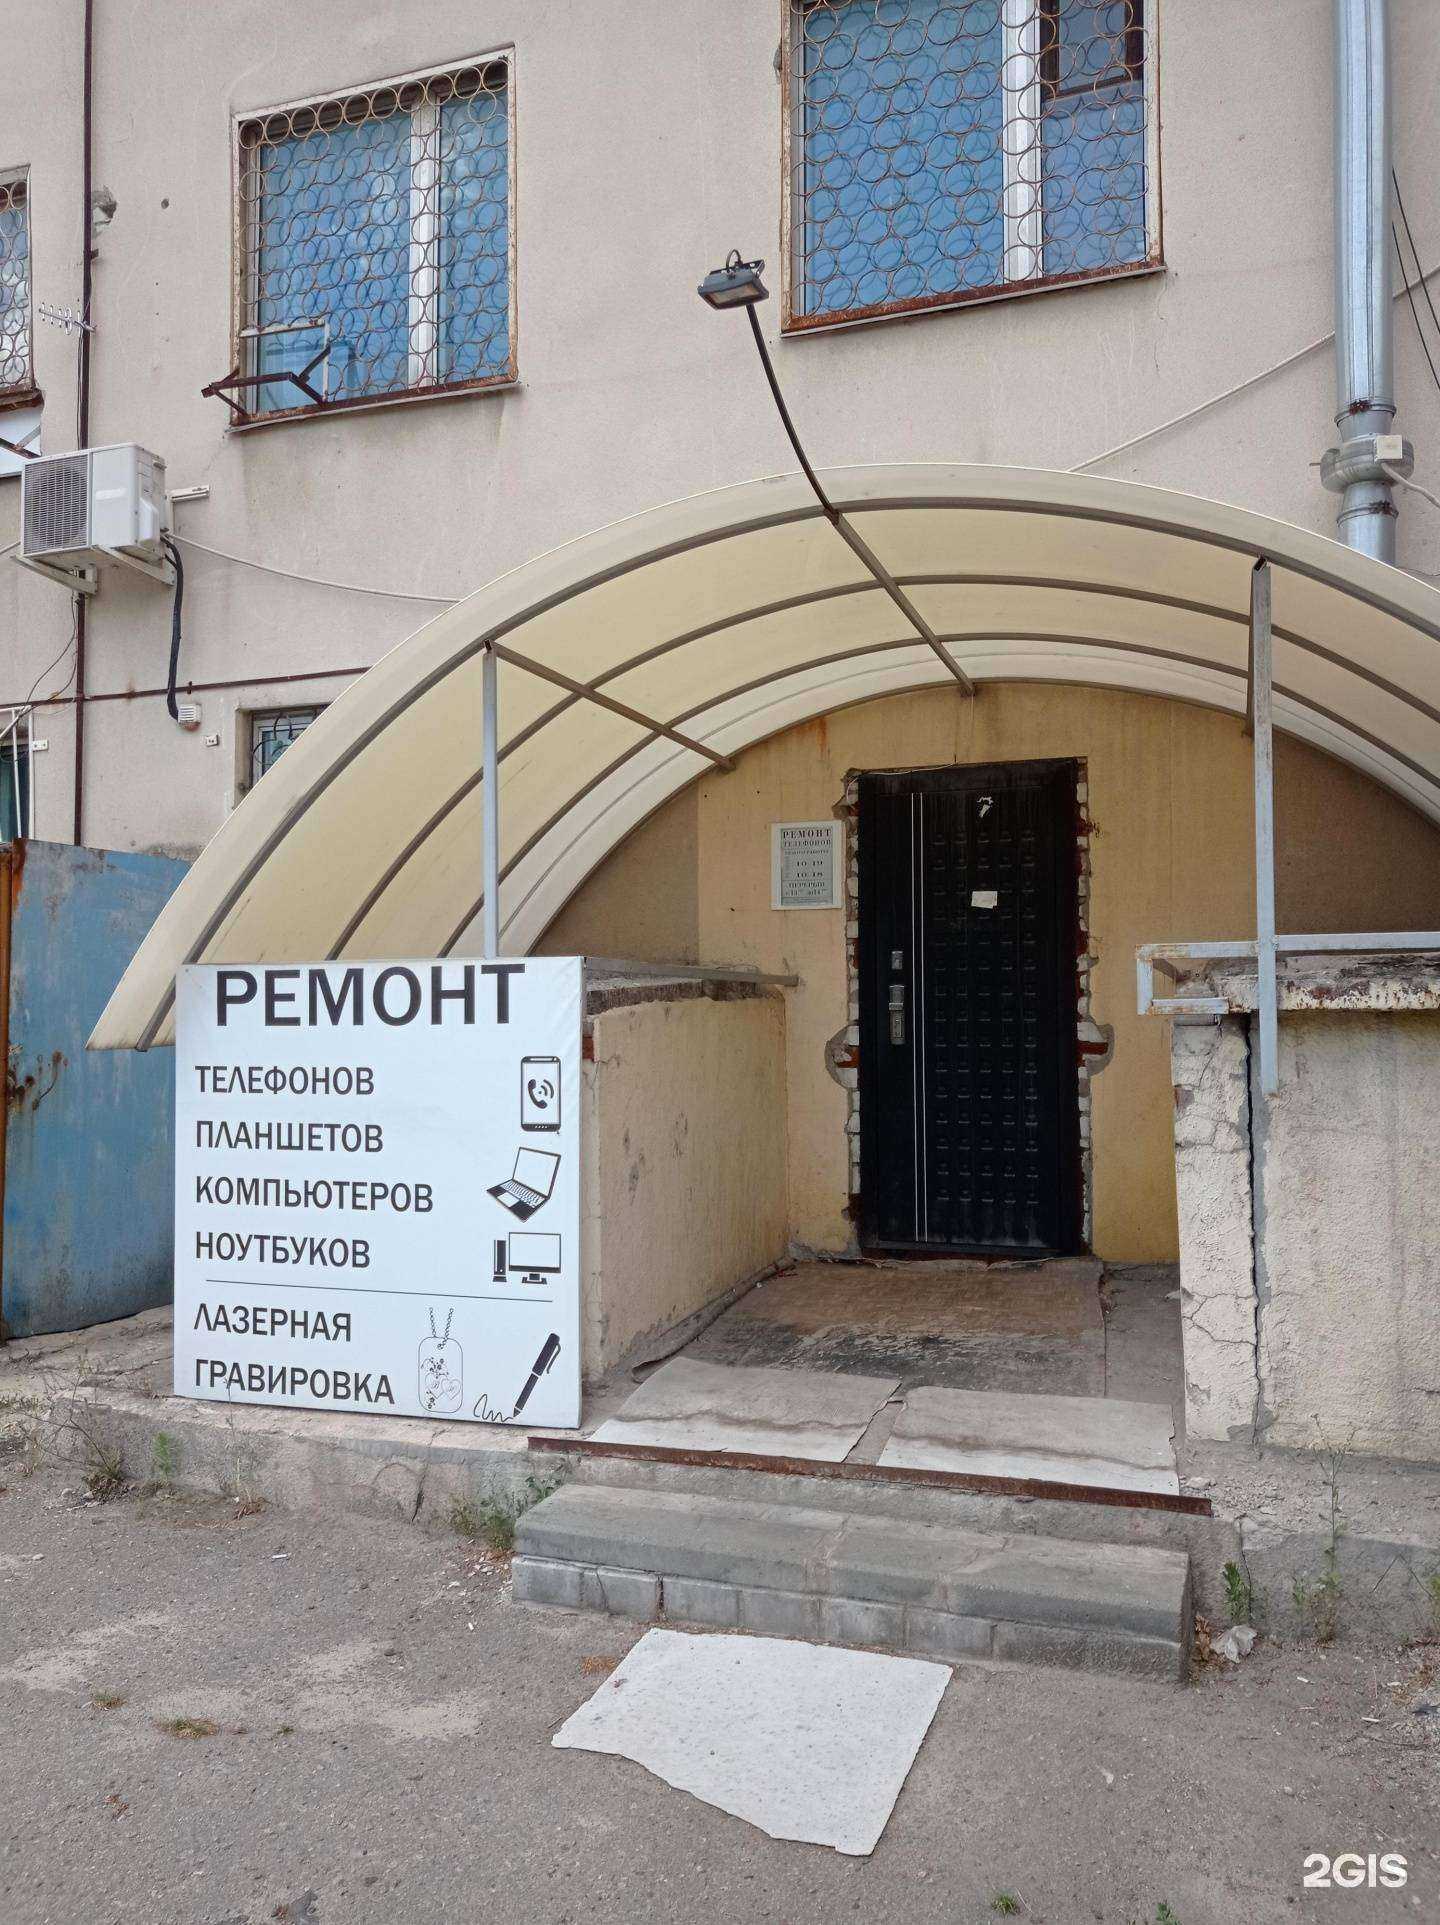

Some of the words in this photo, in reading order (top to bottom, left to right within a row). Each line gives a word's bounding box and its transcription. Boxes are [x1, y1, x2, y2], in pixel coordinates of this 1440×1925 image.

[782, 828, 832, 840] РЕМОНТ
[216, 963, 526, 1027] РЕМОНТ
[195, 1066, 375, 1096] ТЕЛЕФОНОВ
[196, 1121, 383, 1153] ПЛАНШЕТОВ
[196, 1176, 433, 1213] КОМПЬЮТЕРОВ
[196, 1231, 370, 1269] НОУТБУКОВ
[193, 1302, 351, 1342] ЛАЗЕРНАЯ
[194, 1359, 395, 1406] ГРАВИРОВКА
